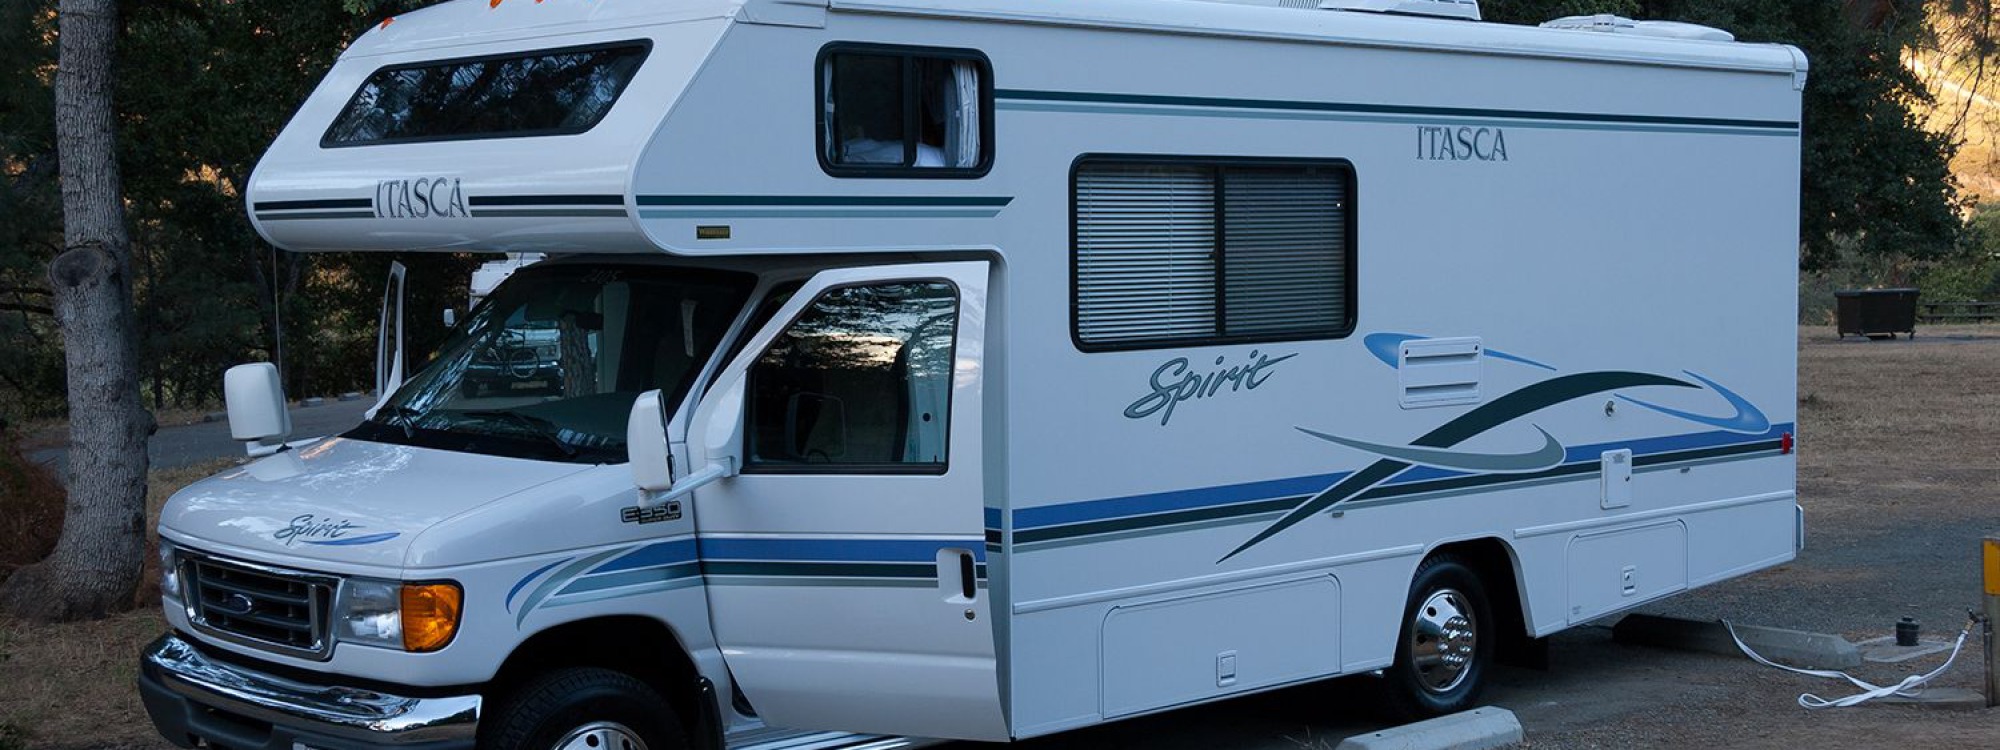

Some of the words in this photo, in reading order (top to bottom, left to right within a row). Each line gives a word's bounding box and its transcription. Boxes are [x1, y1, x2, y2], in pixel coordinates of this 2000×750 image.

[1416, 126, 1508, 161] ITASCA
[375, 176, 468, 218] ITASCA
[1123, 350, 1299, 426] Spirit
[273, 514, 367, 546] Spirit
